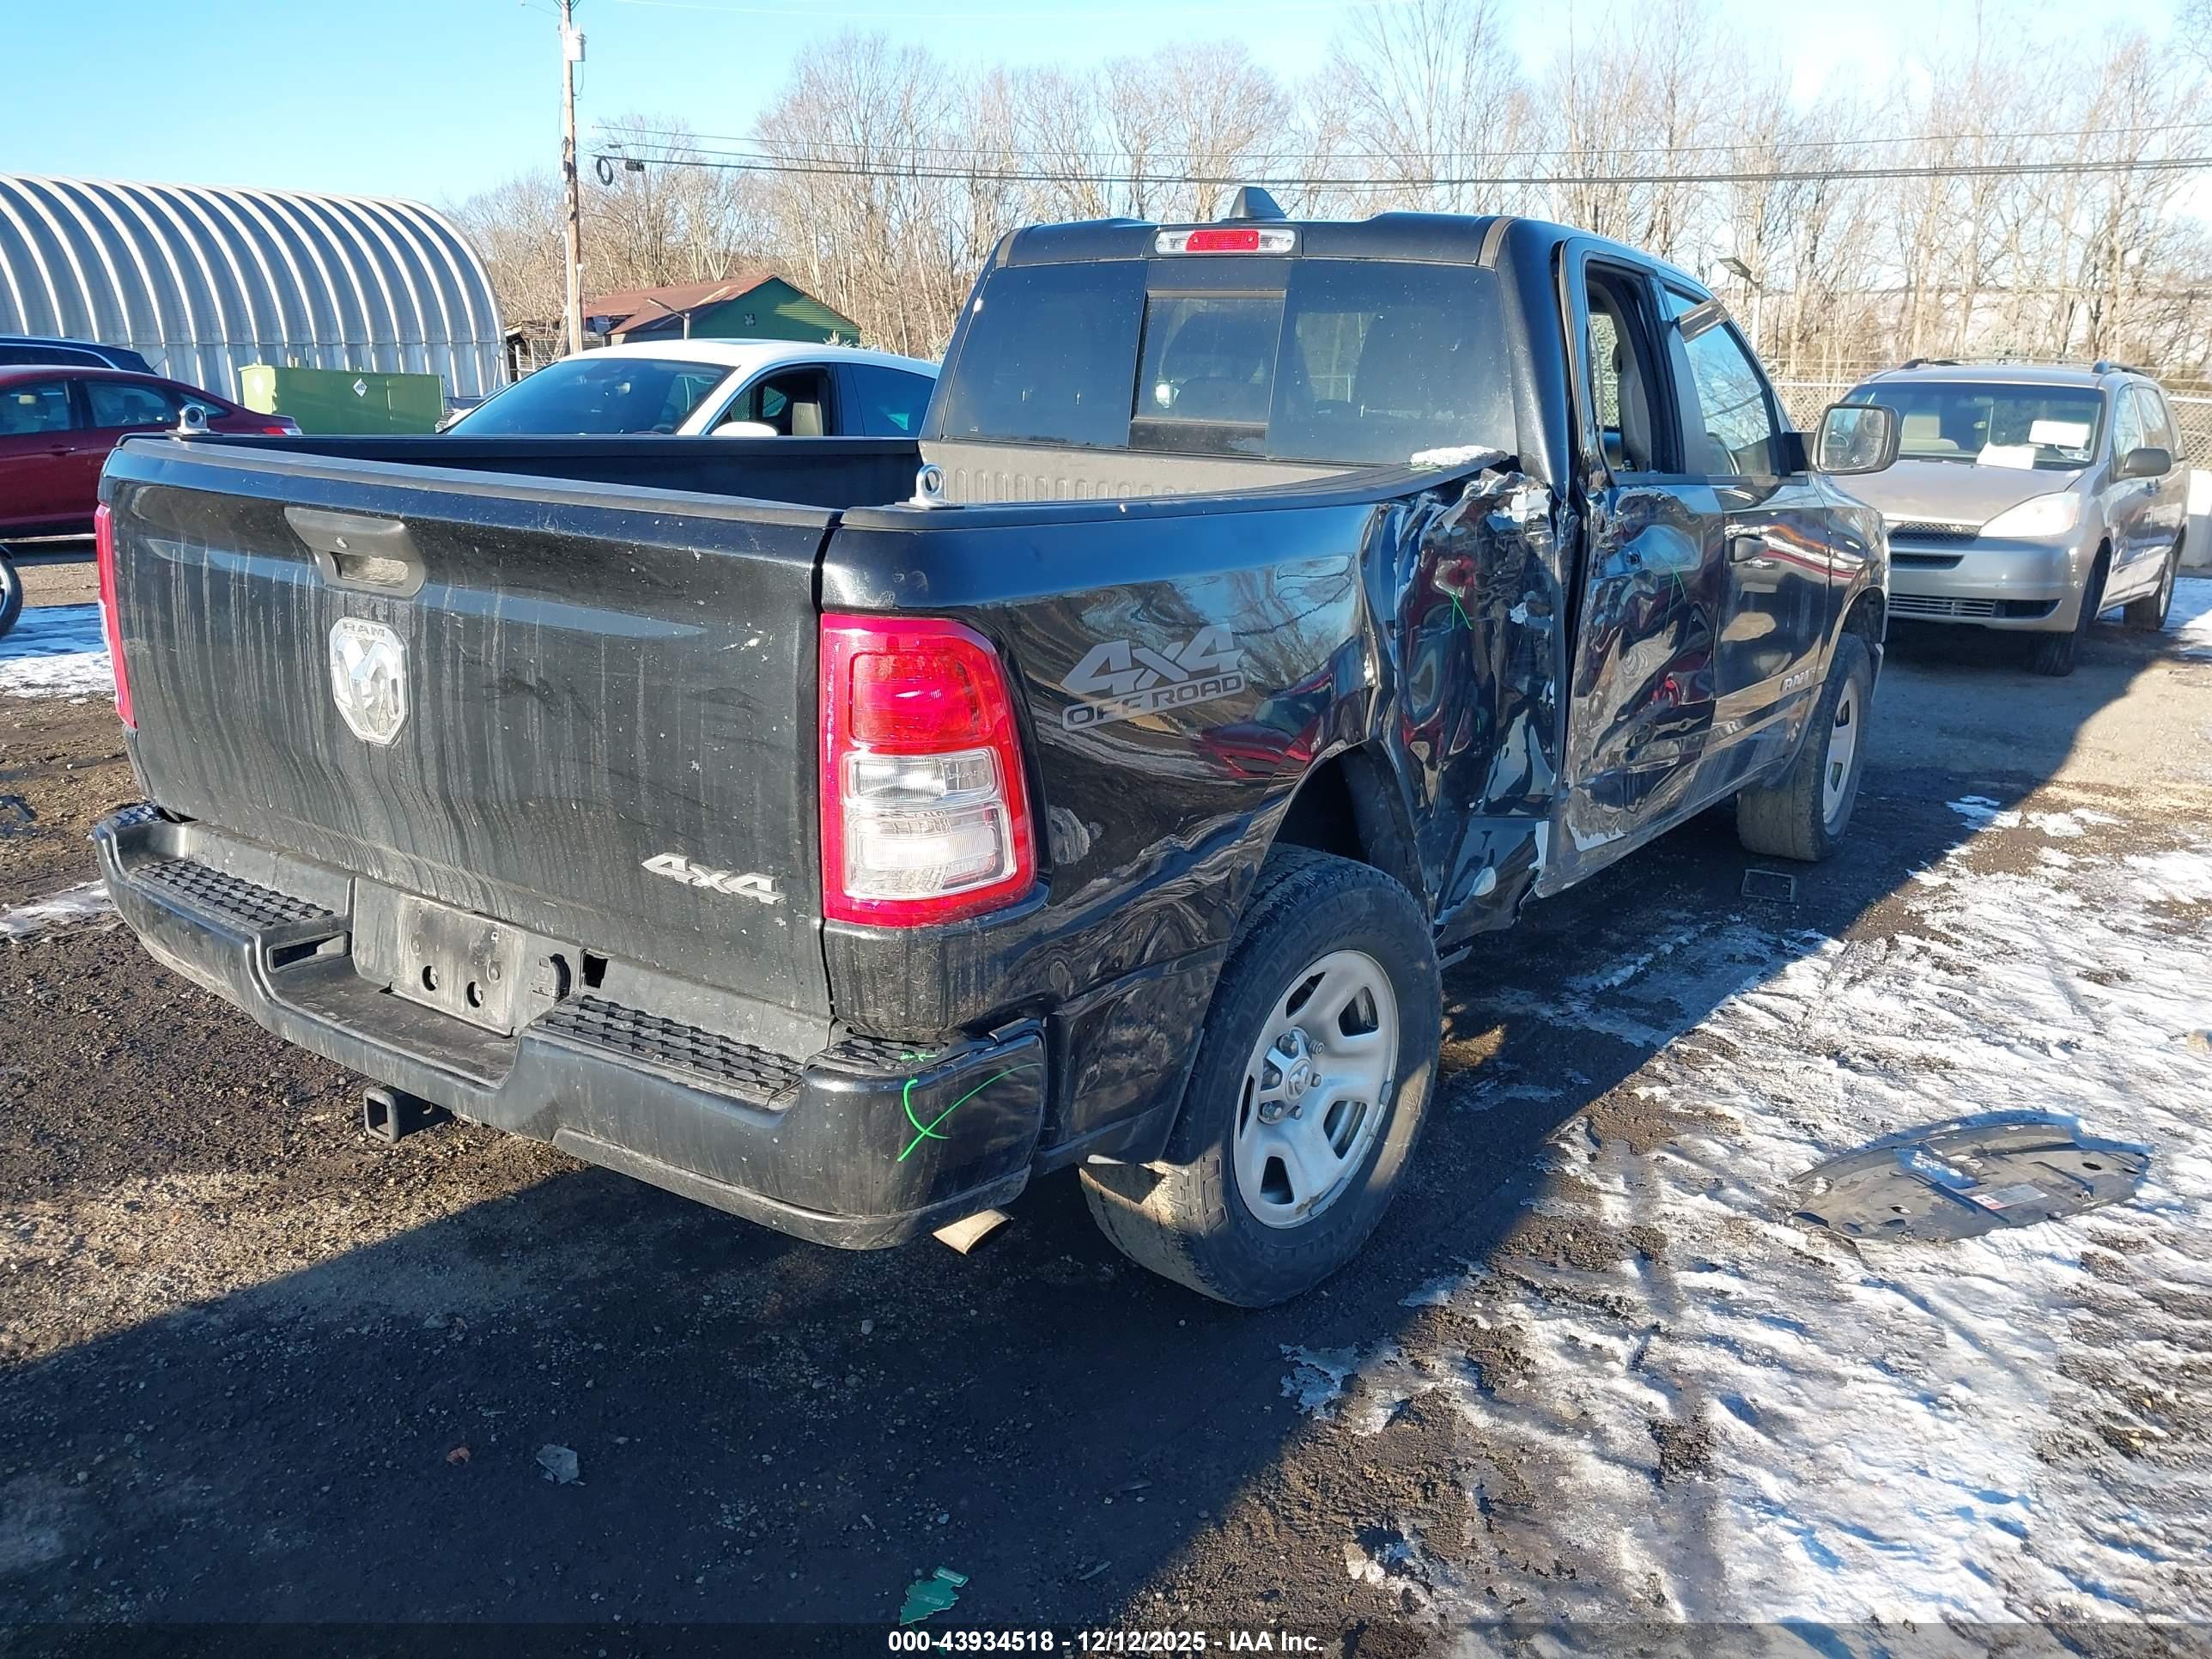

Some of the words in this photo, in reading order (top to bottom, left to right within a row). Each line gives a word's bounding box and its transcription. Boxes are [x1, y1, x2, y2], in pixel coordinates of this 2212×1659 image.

[343, 623, 386, 637] RAM
[1066, 694, 1145, 726] OFF
[1152, 675, 1243, 708] ROAD
